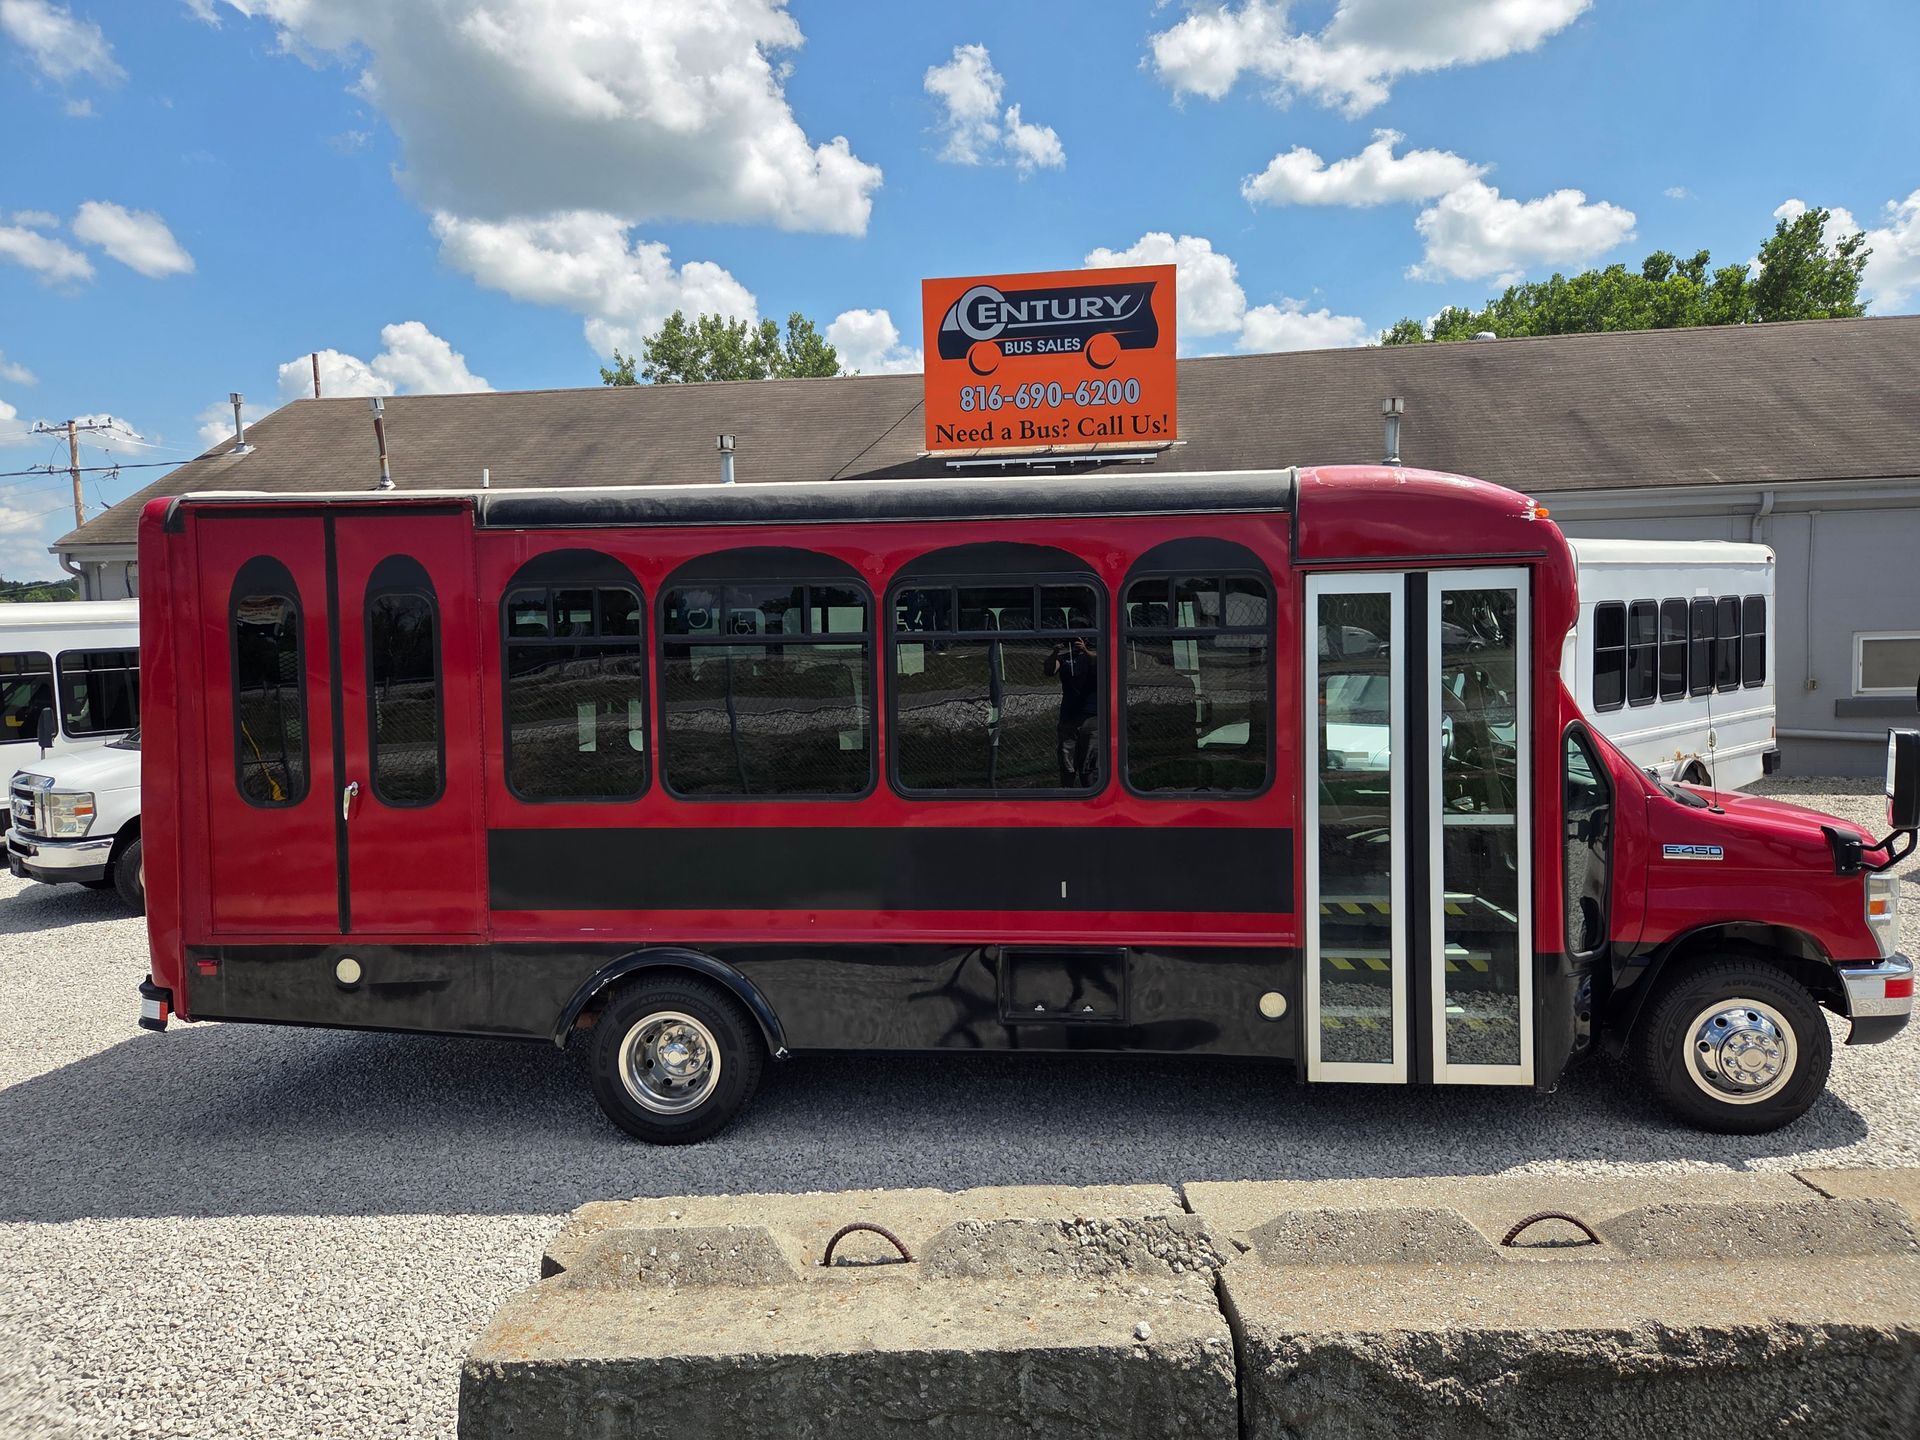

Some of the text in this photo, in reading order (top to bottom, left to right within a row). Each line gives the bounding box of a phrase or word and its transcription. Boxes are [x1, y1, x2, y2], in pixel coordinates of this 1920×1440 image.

[957, 285, 1132, 340] CENTURY
[1004, 338, 1081, 354] BUS SALES
[960, 378, 1141, 412] 816-690-6200
[935, 414, 1169, 443] Need a Bus? Call Us!
